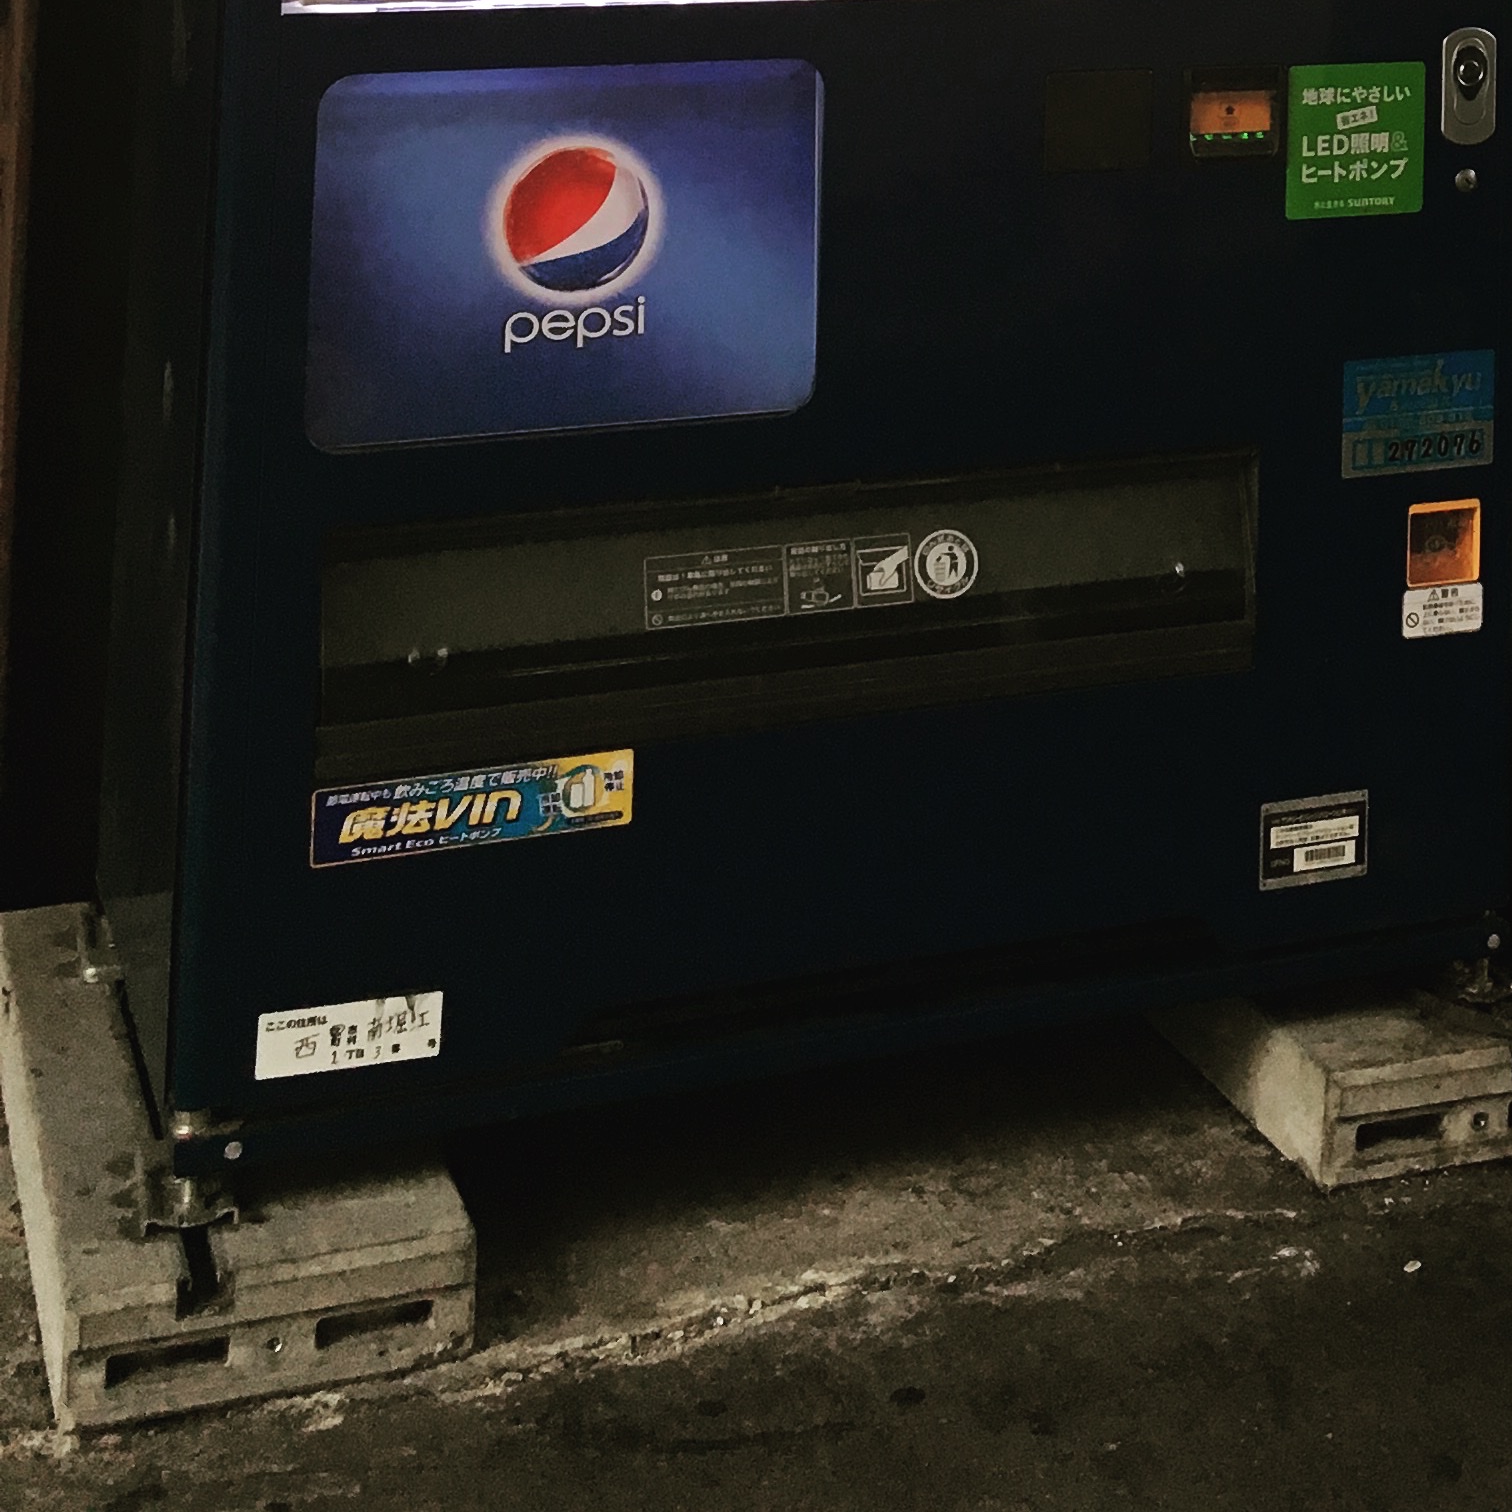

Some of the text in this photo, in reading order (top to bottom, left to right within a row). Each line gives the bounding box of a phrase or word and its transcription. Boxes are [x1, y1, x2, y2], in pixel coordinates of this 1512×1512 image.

[1301, 85, 1412, 106] 地球にやさしい
[1301, 157, 1409, 184] ヒートポンプ
[503, 296, 646, 354] pepsi
[349, 841, 403, 858] Smart
[405, 836, 435, 851] Eco
